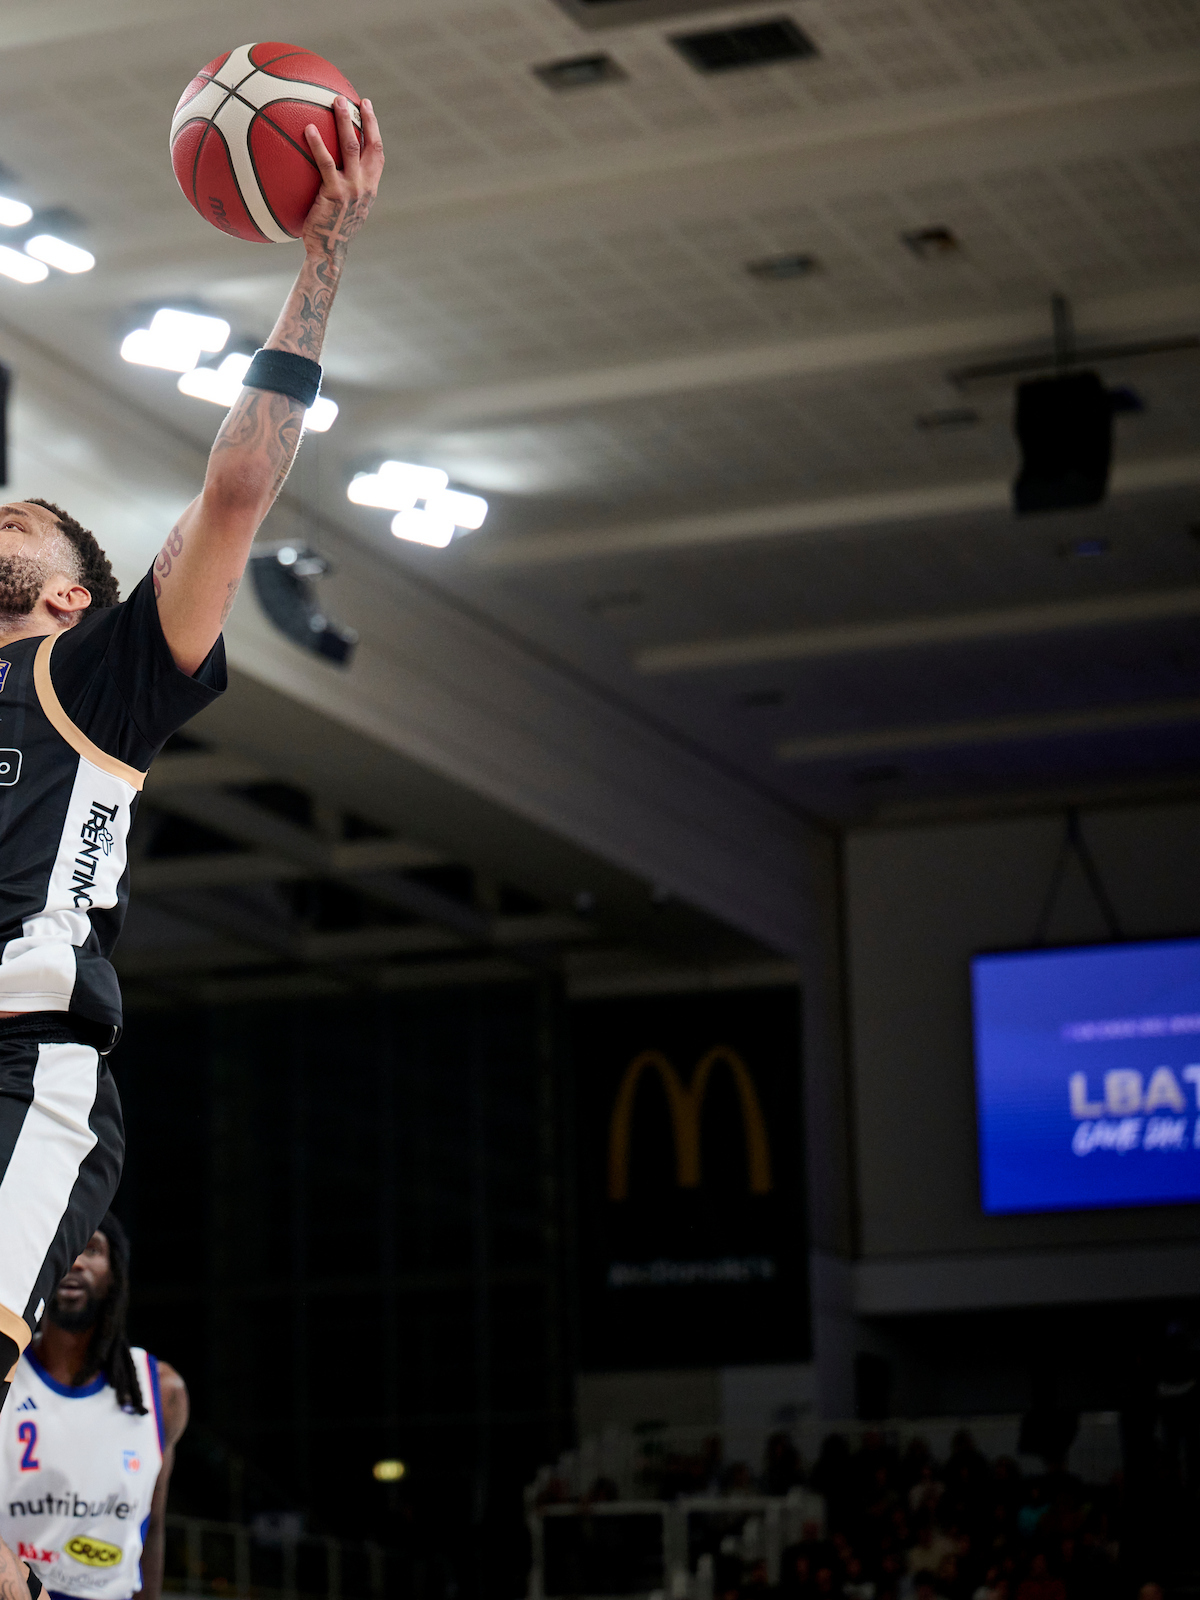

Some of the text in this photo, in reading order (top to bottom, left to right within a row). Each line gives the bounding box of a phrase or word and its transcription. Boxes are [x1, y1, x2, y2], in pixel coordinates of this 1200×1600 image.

[68, 801, 120, 909] TRENTINO
[18, 1421, 41, 1472] 2
[9, 1491, 136, 1520] nutribulle
